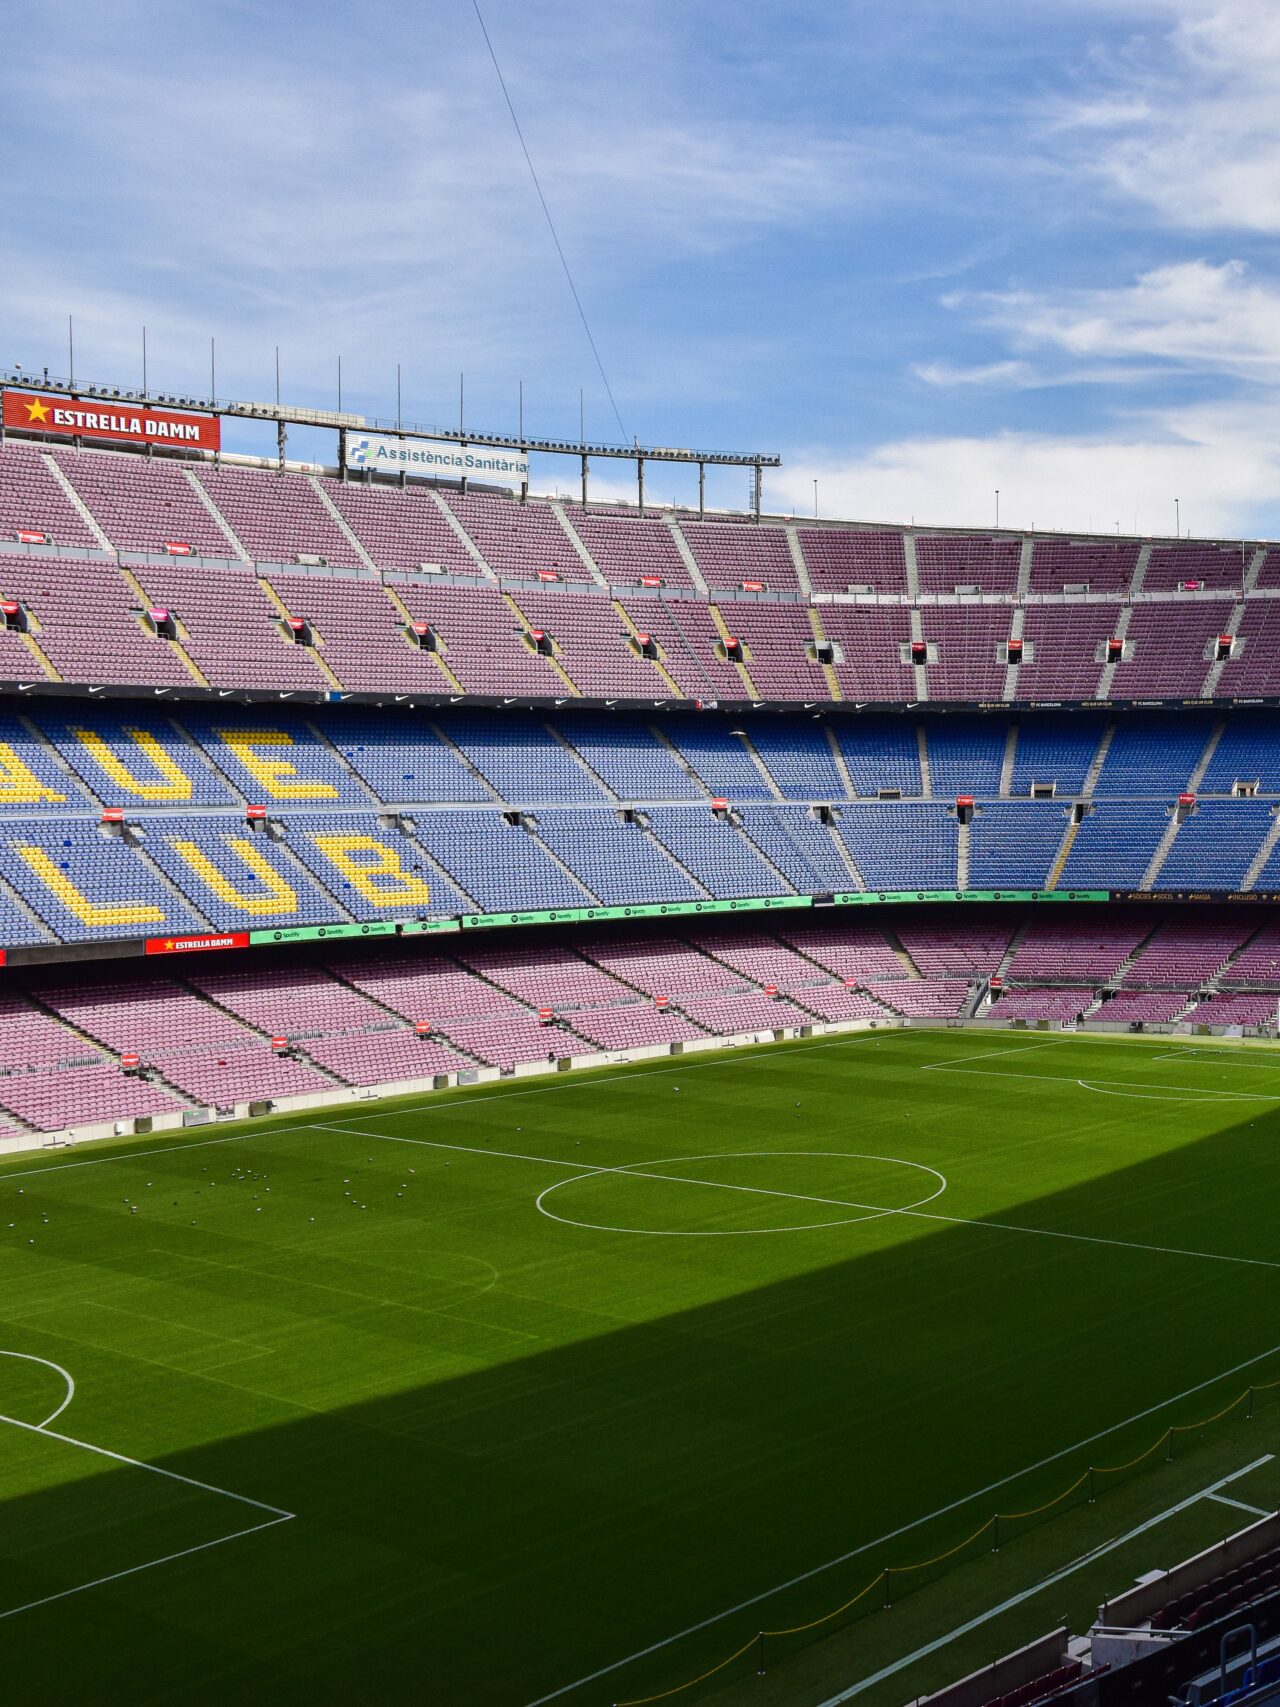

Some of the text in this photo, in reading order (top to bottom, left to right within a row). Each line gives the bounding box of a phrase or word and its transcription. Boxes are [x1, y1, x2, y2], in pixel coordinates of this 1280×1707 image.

[54, 408, 200, 441] ESTRELLA DAMM
[376, 445, 528, 473] Assistència Sanitària
[175, 938, 233, 950] ESTRELLA DAMM
